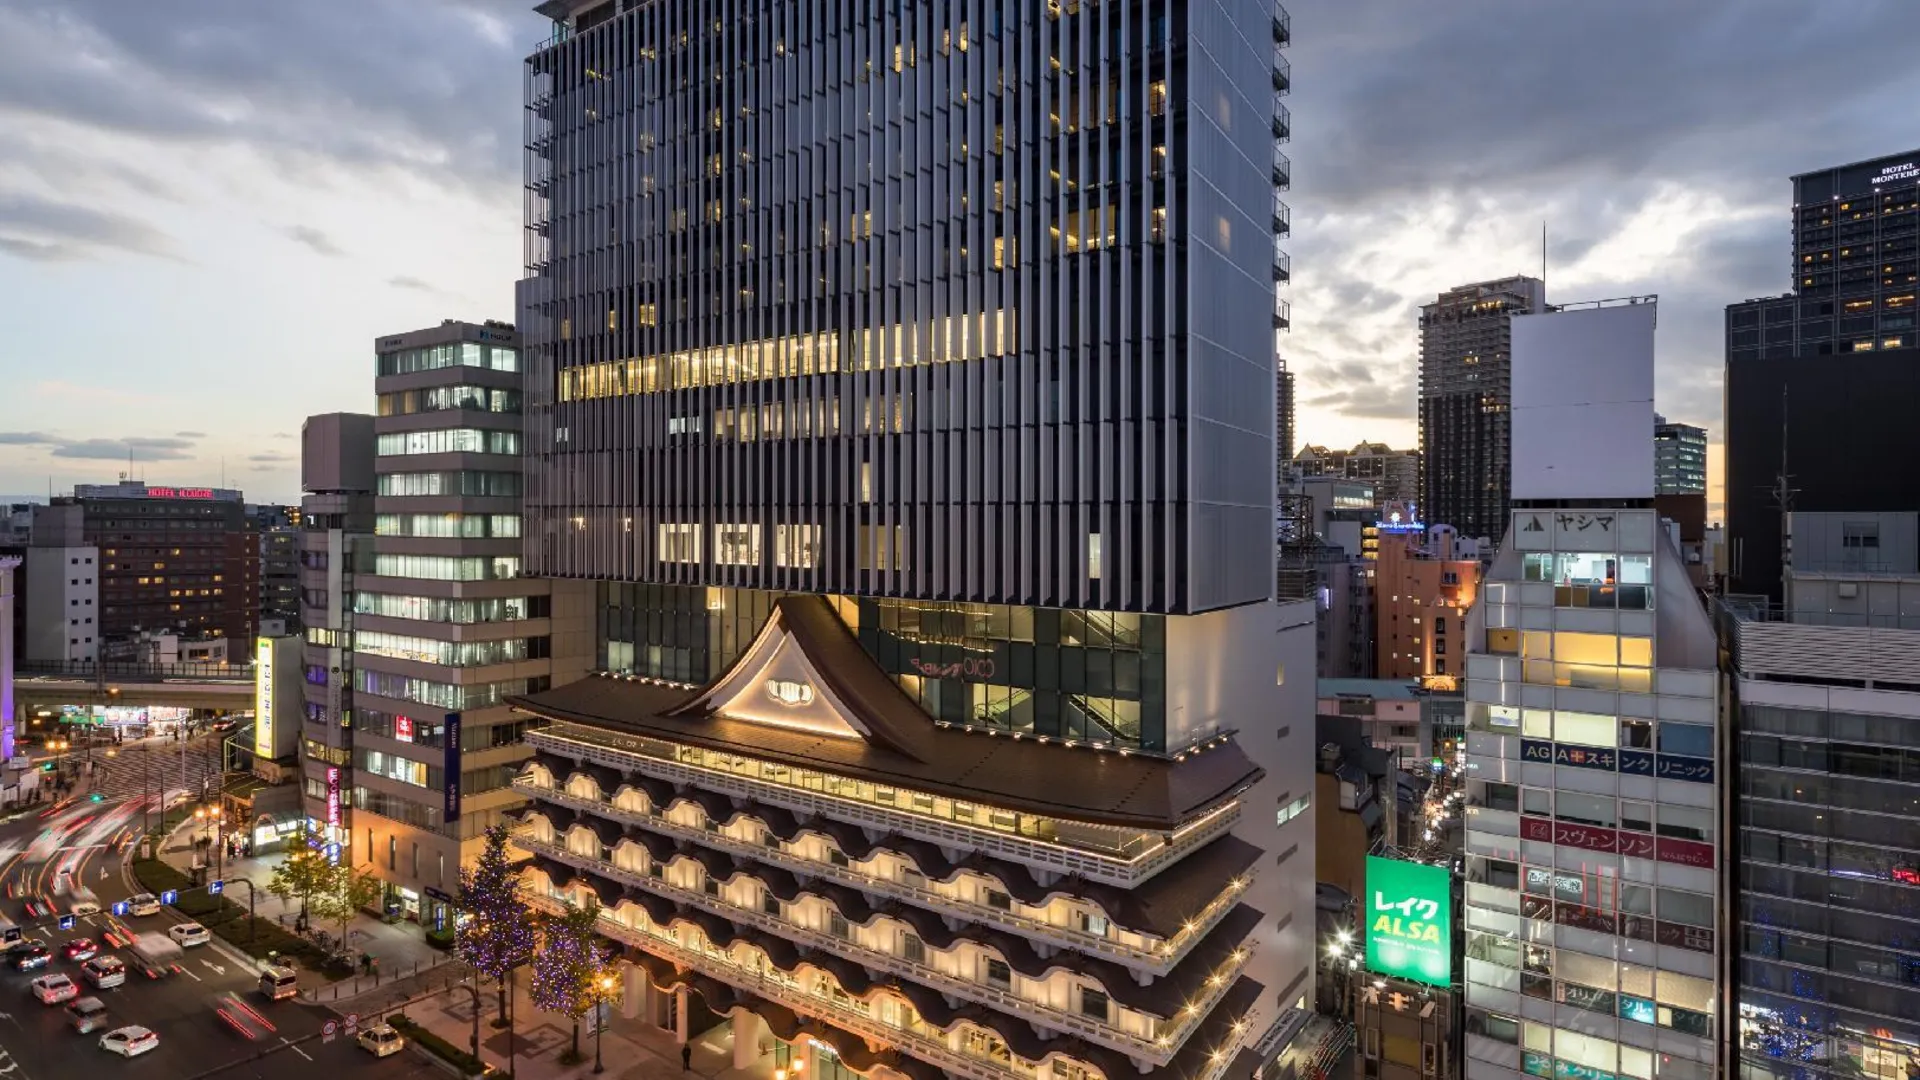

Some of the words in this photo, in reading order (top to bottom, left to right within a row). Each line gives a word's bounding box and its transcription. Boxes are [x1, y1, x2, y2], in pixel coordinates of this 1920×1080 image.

[1871, 169, 1920, 184] MONTERE
[1882, 162, 1915, 174] HOTEL
[1556, 514, 1614, 532] ヤシマ
[1526, 745, 1568, 761] AGA
[1586, 752, 1710, 777] スキンクリニック
[1557, 829, 1652, 854] スヴェンソン
[1375, 890, 1439, 920] レイク
[1373, 914, 1440, 944] ALSA
